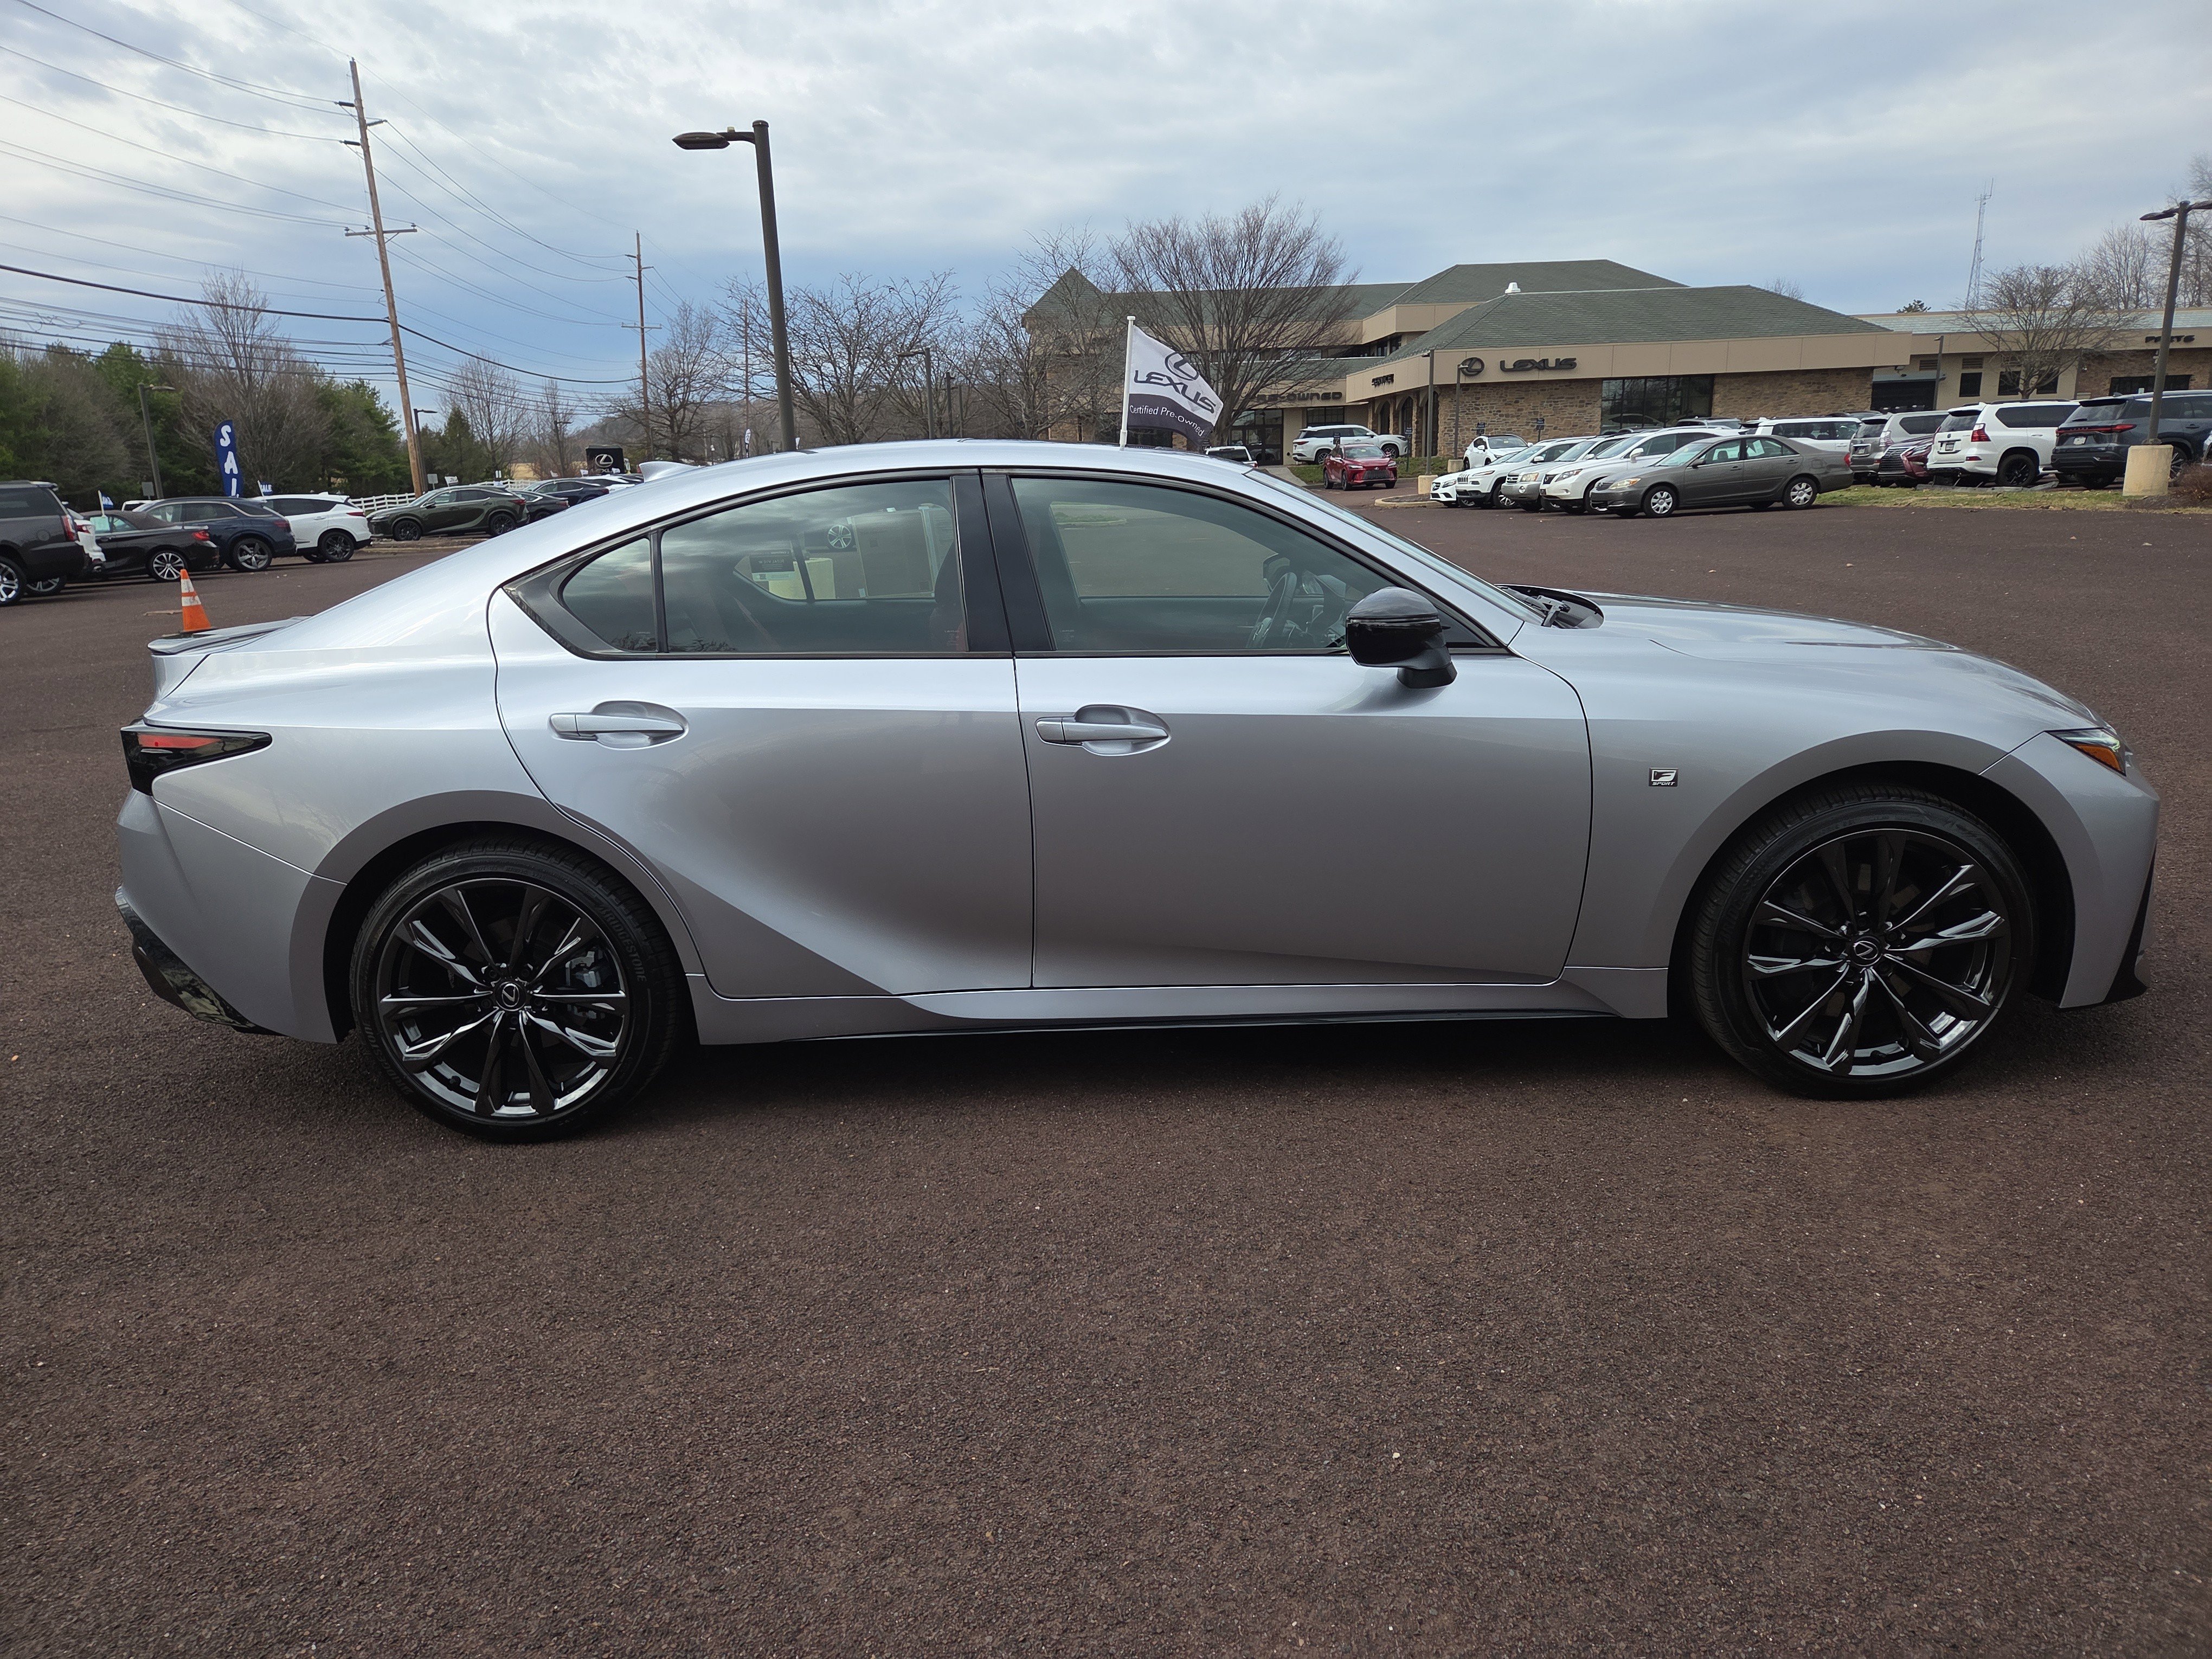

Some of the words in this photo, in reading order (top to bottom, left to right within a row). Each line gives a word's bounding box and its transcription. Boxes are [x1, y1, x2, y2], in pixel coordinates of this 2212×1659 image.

[1500, 357, 1577, 372] LEXUS
[1134, 370, 1216, 414] LEXUS
[1129, 405, 1159, 415] Certified
[1160, 407, 1205, 437] Pre-Owned
[594, 905, 647, 982] BRIDGESTONE
